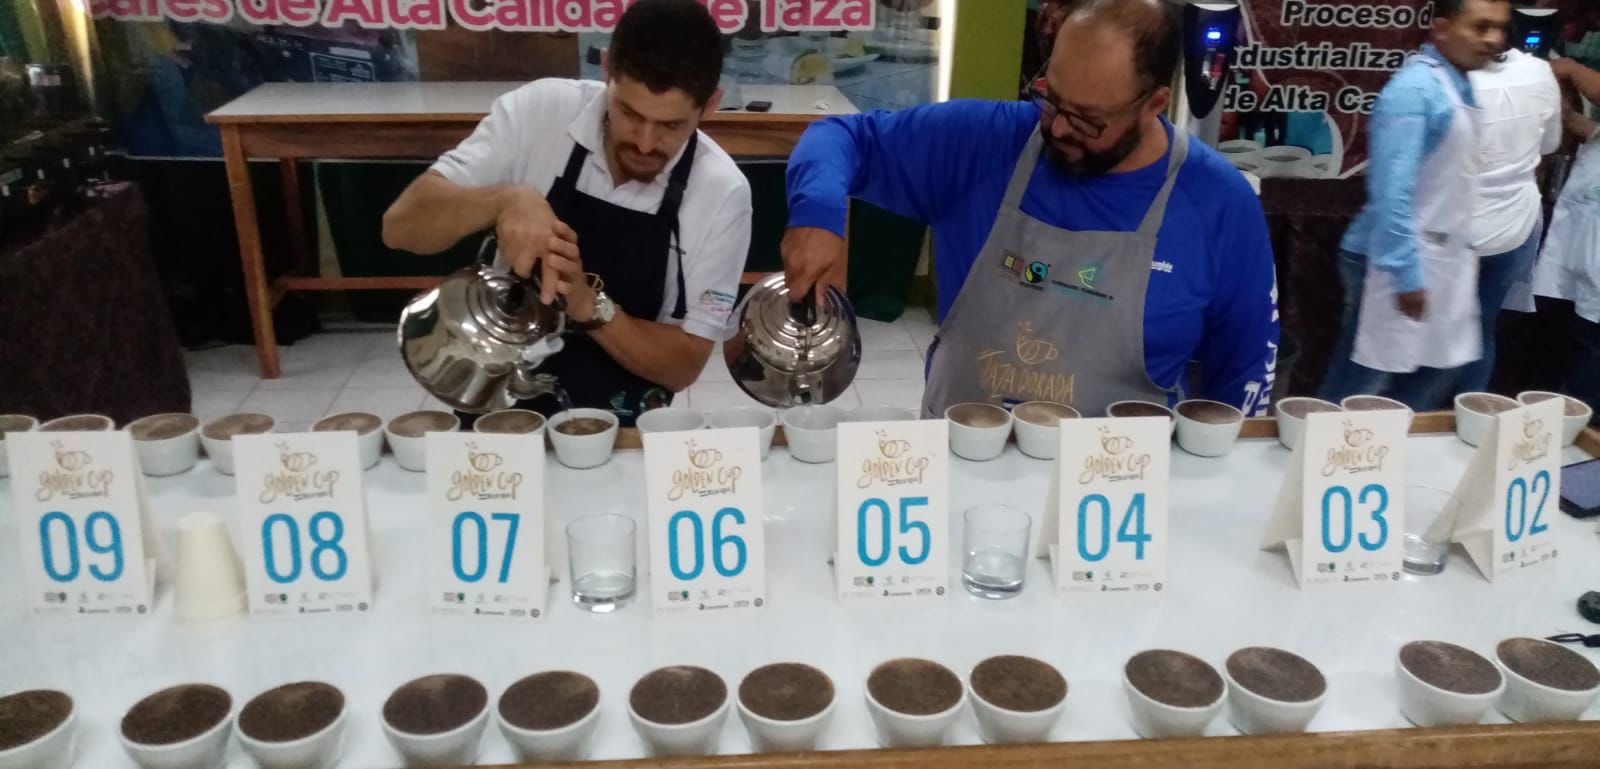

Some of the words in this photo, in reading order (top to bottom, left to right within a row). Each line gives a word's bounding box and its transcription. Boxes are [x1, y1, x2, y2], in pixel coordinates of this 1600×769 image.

[452, 0, 633, 28] Calida
[1284, 3, 1412, 27] Proceso
[1223, 87, 1256, 111] de
[1264, 86, 1328, 111] Alta
[1339, 86, 1379, 113] Ca
[857, 496, 931, 567] 05
[1077, 493, 1152, 562] 04
[1321, 484, 1389, 552] 03
[1505, 470, 1551, 542] 02
[39, 511, 125, 582] 09
[261, 511, 348, 584] 08
[452, 511, 521, 583] 07
[667, 507, 748, 581] 06
